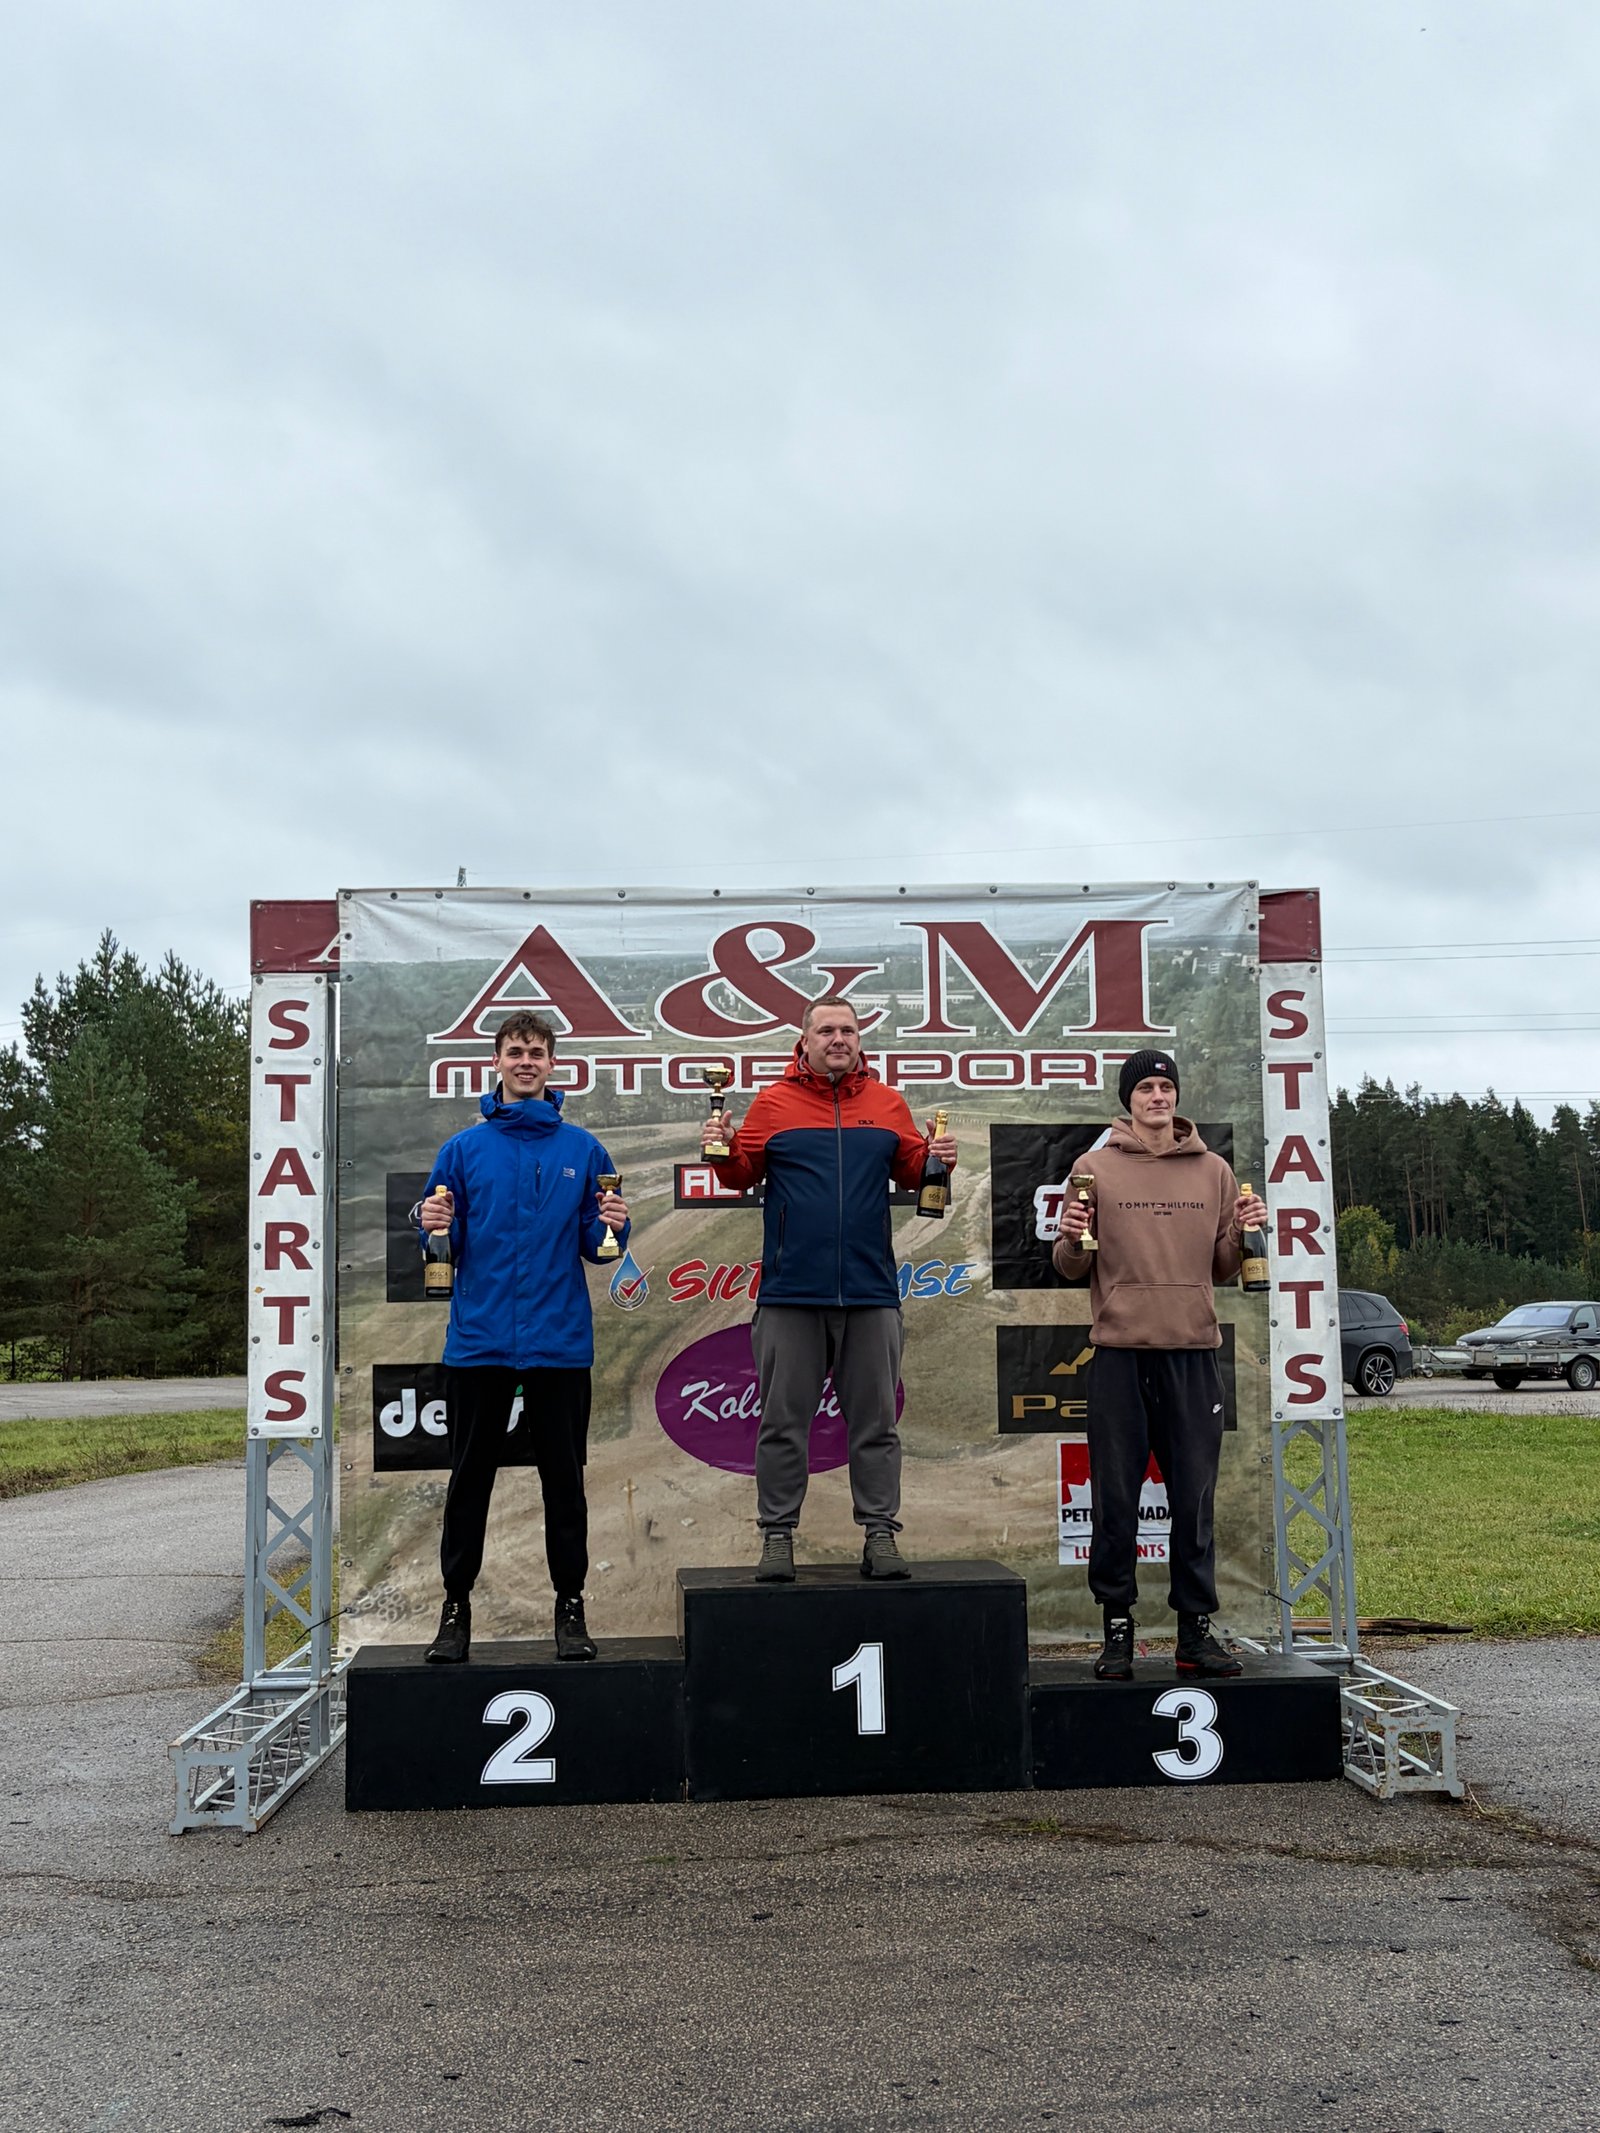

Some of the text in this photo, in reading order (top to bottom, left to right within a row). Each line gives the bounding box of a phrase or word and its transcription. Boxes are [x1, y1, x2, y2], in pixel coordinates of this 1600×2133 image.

[257, 999, 317, 1422] STARTS
[1266, 989, 1328, 1405] STARTS
[831, 1641, 886, 1736] 1
[1151, 1687, 1224, 1781] 3
[480, 1690, 556, 1785] 2
